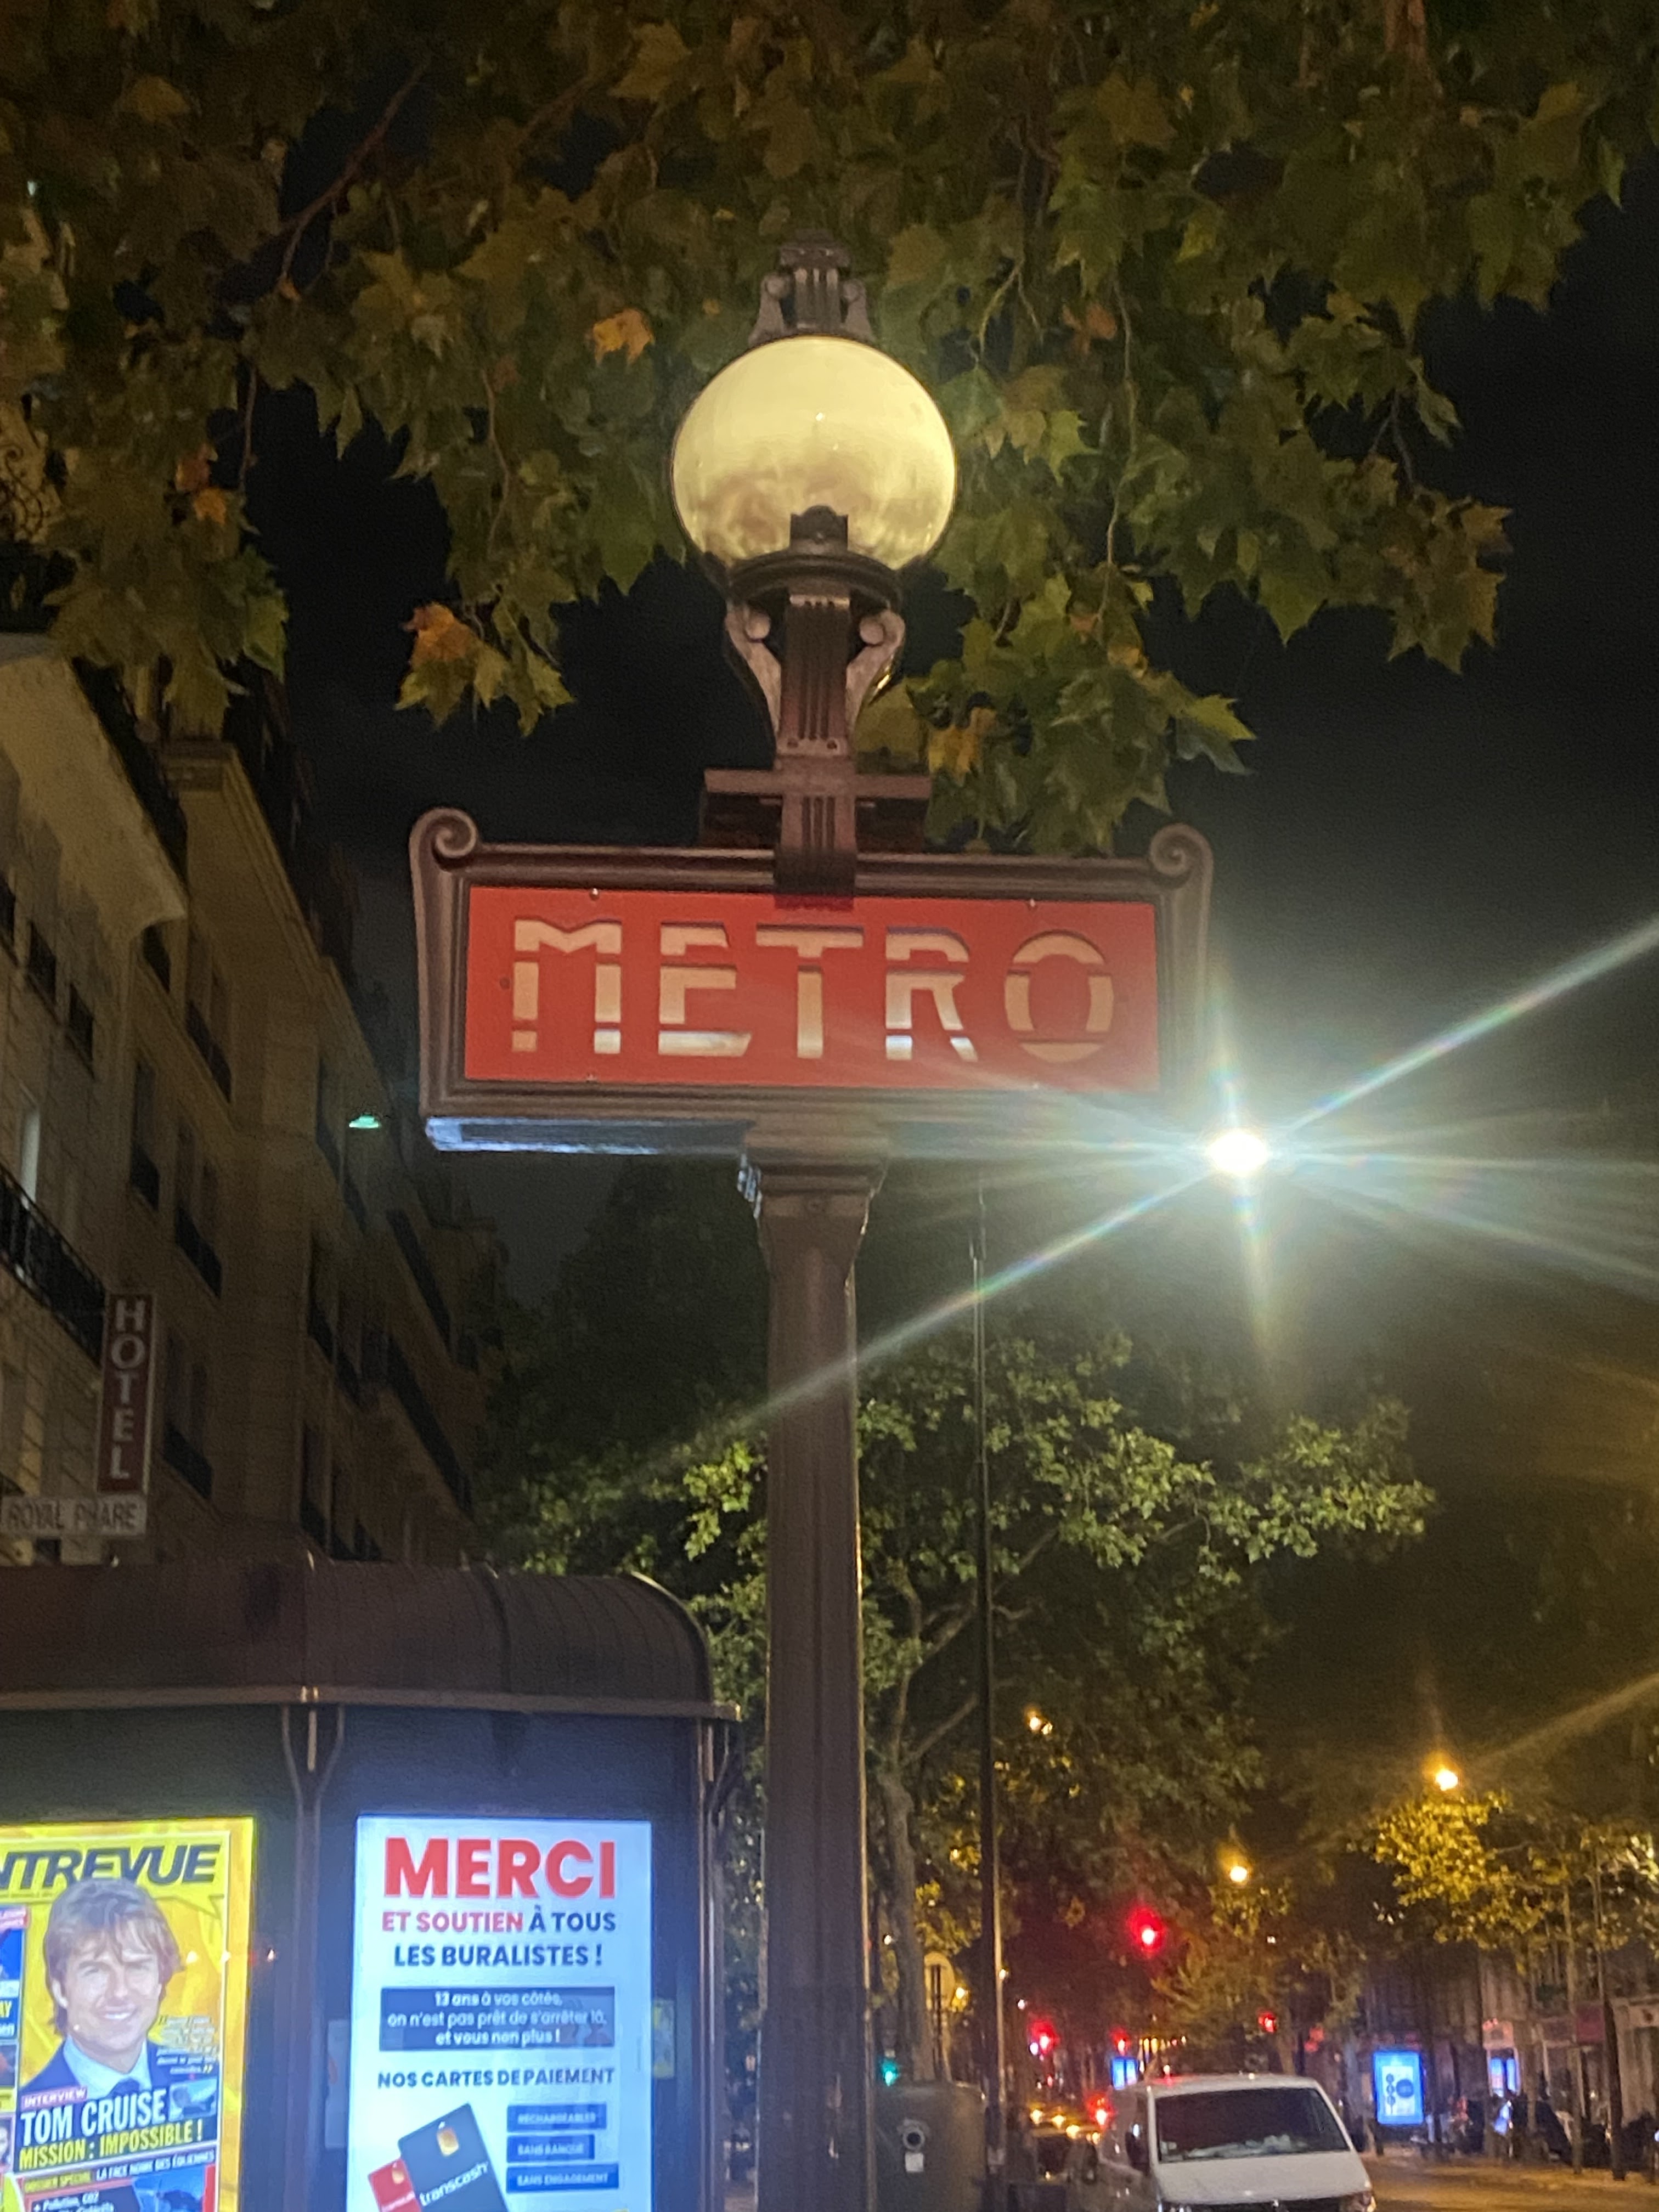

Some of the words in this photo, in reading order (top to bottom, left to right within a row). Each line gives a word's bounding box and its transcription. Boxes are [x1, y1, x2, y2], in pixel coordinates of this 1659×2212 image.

[511, 916, 1114, 1063] METRO
[111, 1299, 146, 1479] HOTEL
[385, 1837, 615, 1898] MERCI
[382, 1911, 411, 1932] ET
[416, 1911, 523, 1932] SOUTIEN
[528, 1905, 546, 1932] À
[552, 1912, 616, 1932] TOUS
[394, 1945, 435, 1966] LES
[442, 1944, 589, 1967] BURALISTES
[596, 1944, 602, 1966] !
[435, 1991, 450, 2007] 13
[452, 1993, 479, 2007] ans
[493, 1993, 520, 2006] vos
[387, 2012, 407, 2028] on
[448, 2013, 475, 2029] pas
[478, 2010, 507, 2029] prêt
[509, 2010, 528, 2025] de
[435, 2030, 452, 2045] et
[454, 2032, 489, 2045] vous
[492, 2032, 520, 2045] non
[521, 2029, 553, 2049] plus
[379, 2071, 417, 2089] NOS
[421, 2069, 493, 2087] CARTES
[497, 2069, 520, 2085] DE
[523, 2067, 615, 2085] PAIEMENT
[24, 2089, 87, 2108] INTERVIEW
[20, 2104, 74, 2146] TOM
[81, 2089, 166, 2137] CRUISE
[19, 2139, 86, 2170] MISSION
[99, 2119, 193, 2158] IMPOSSIBLE
[419, 2160, 489, 2207] transcash
